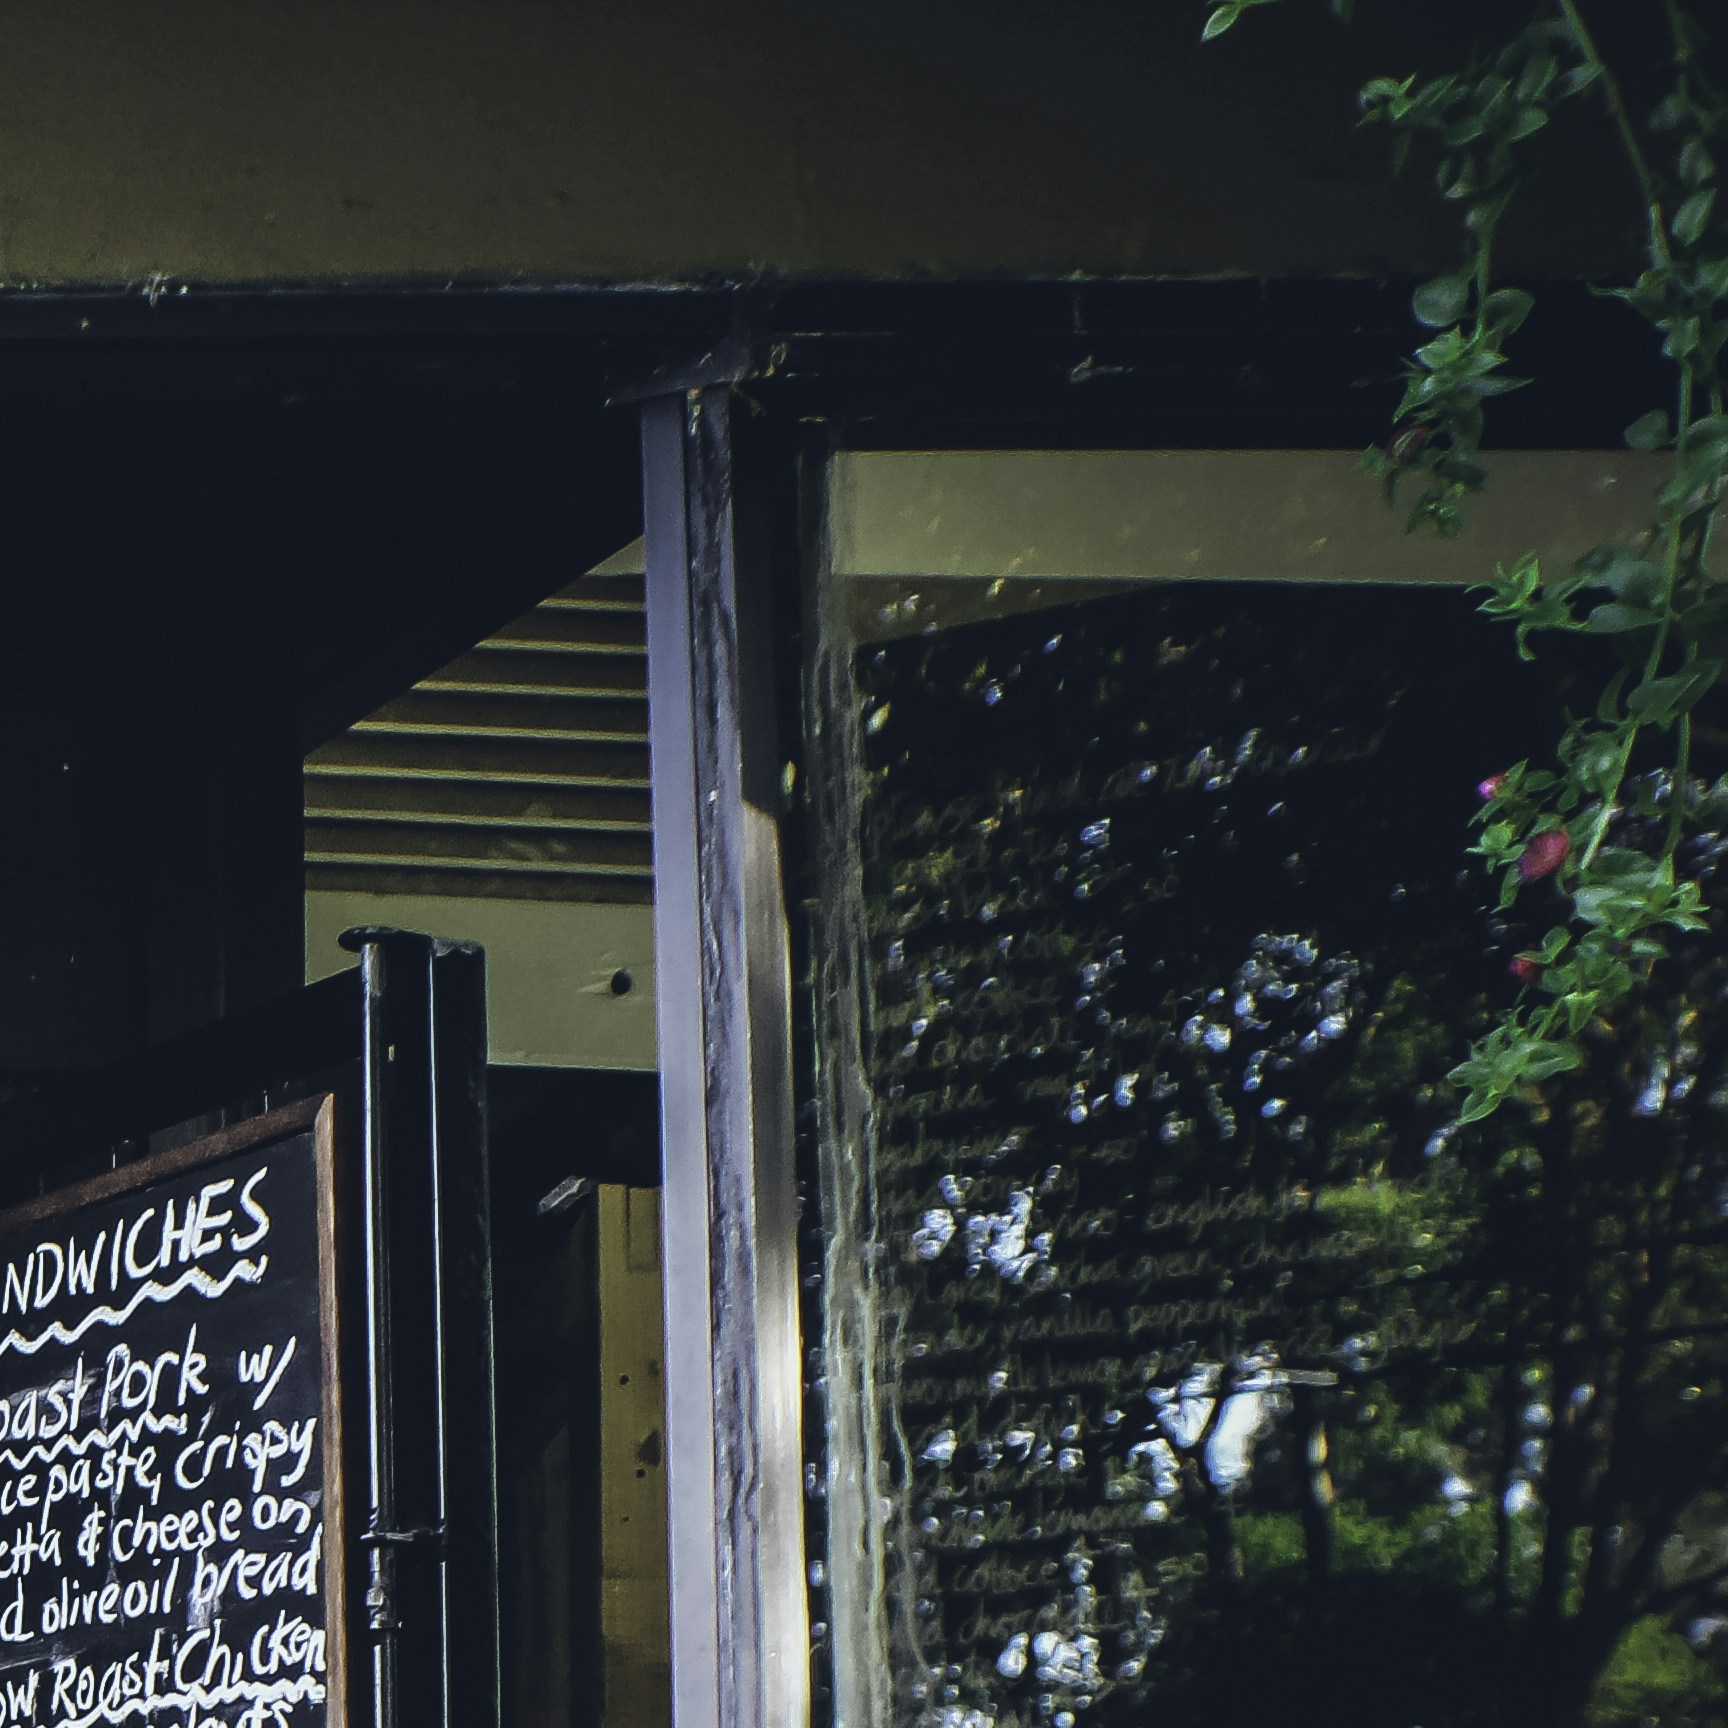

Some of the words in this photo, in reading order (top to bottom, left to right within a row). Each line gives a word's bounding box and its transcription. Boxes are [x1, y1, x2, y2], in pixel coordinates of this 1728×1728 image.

[100, 1322, 209, 1419] Pork
[112, 1497, 243, 1562] cheese
[192, 1522, 322, 1604] bread
[52, 1628, 169, 1717] Roast
